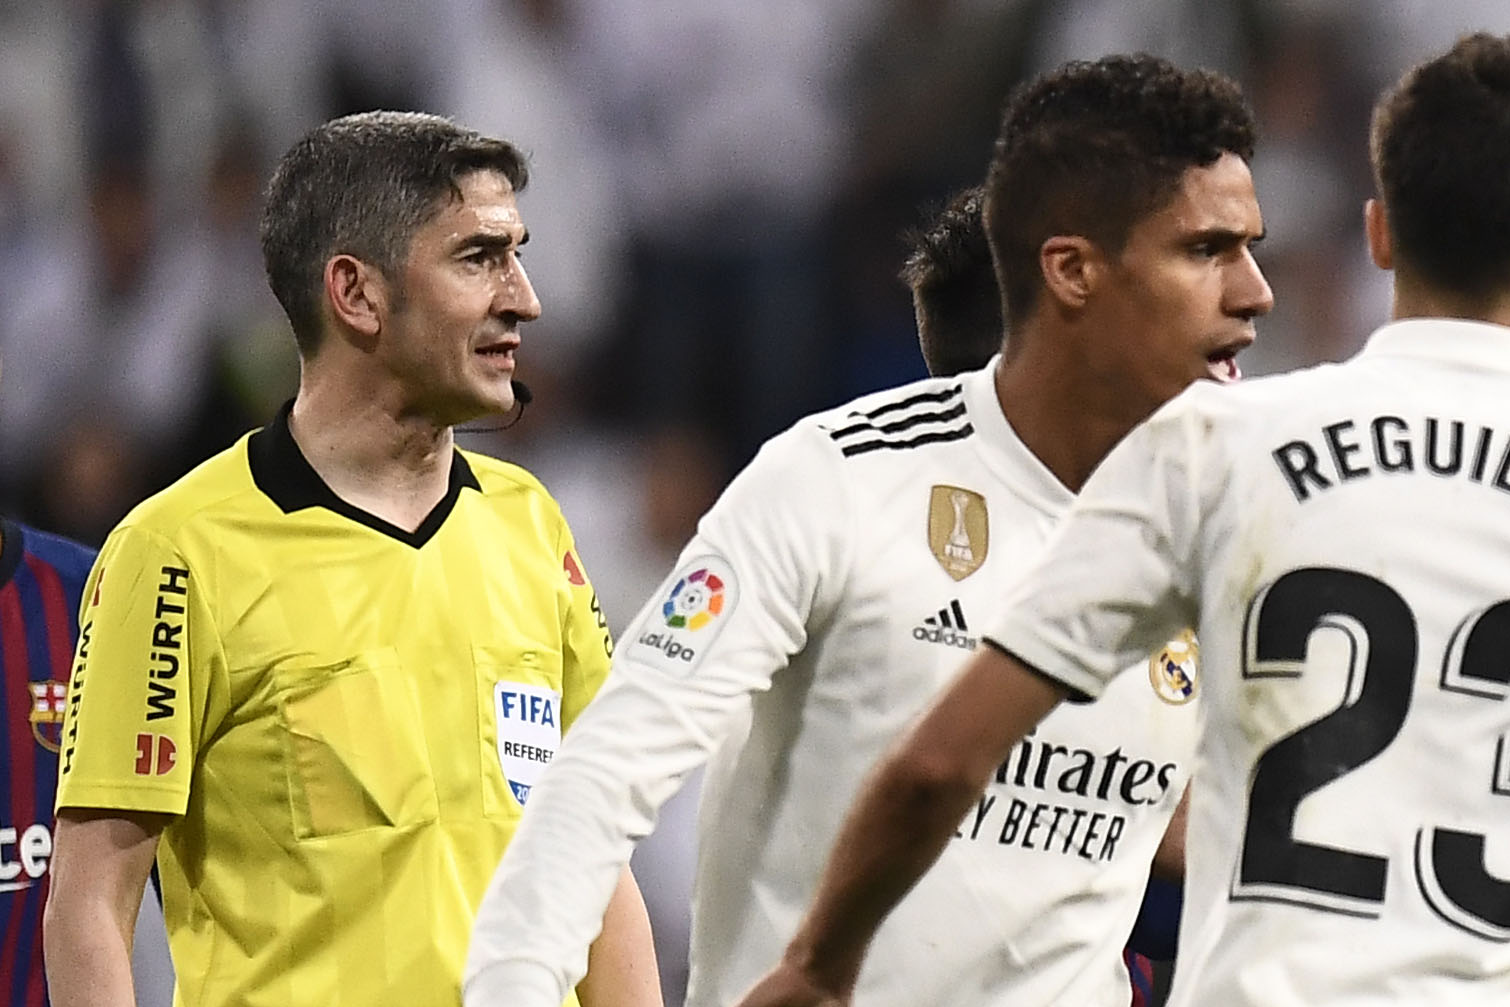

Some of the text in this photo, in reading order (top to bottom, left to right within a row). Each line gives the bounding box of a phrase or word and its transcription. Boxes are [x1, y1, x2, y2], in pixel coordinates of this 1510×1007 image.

[146, 566, 190, 721] WÜRTH
[912, 626, 977, 651] adidas
[501, 691, 554, 728] FIFA
[996, 726, 1177, 806] irates
[998, 798, 1125, 862] BETTER
